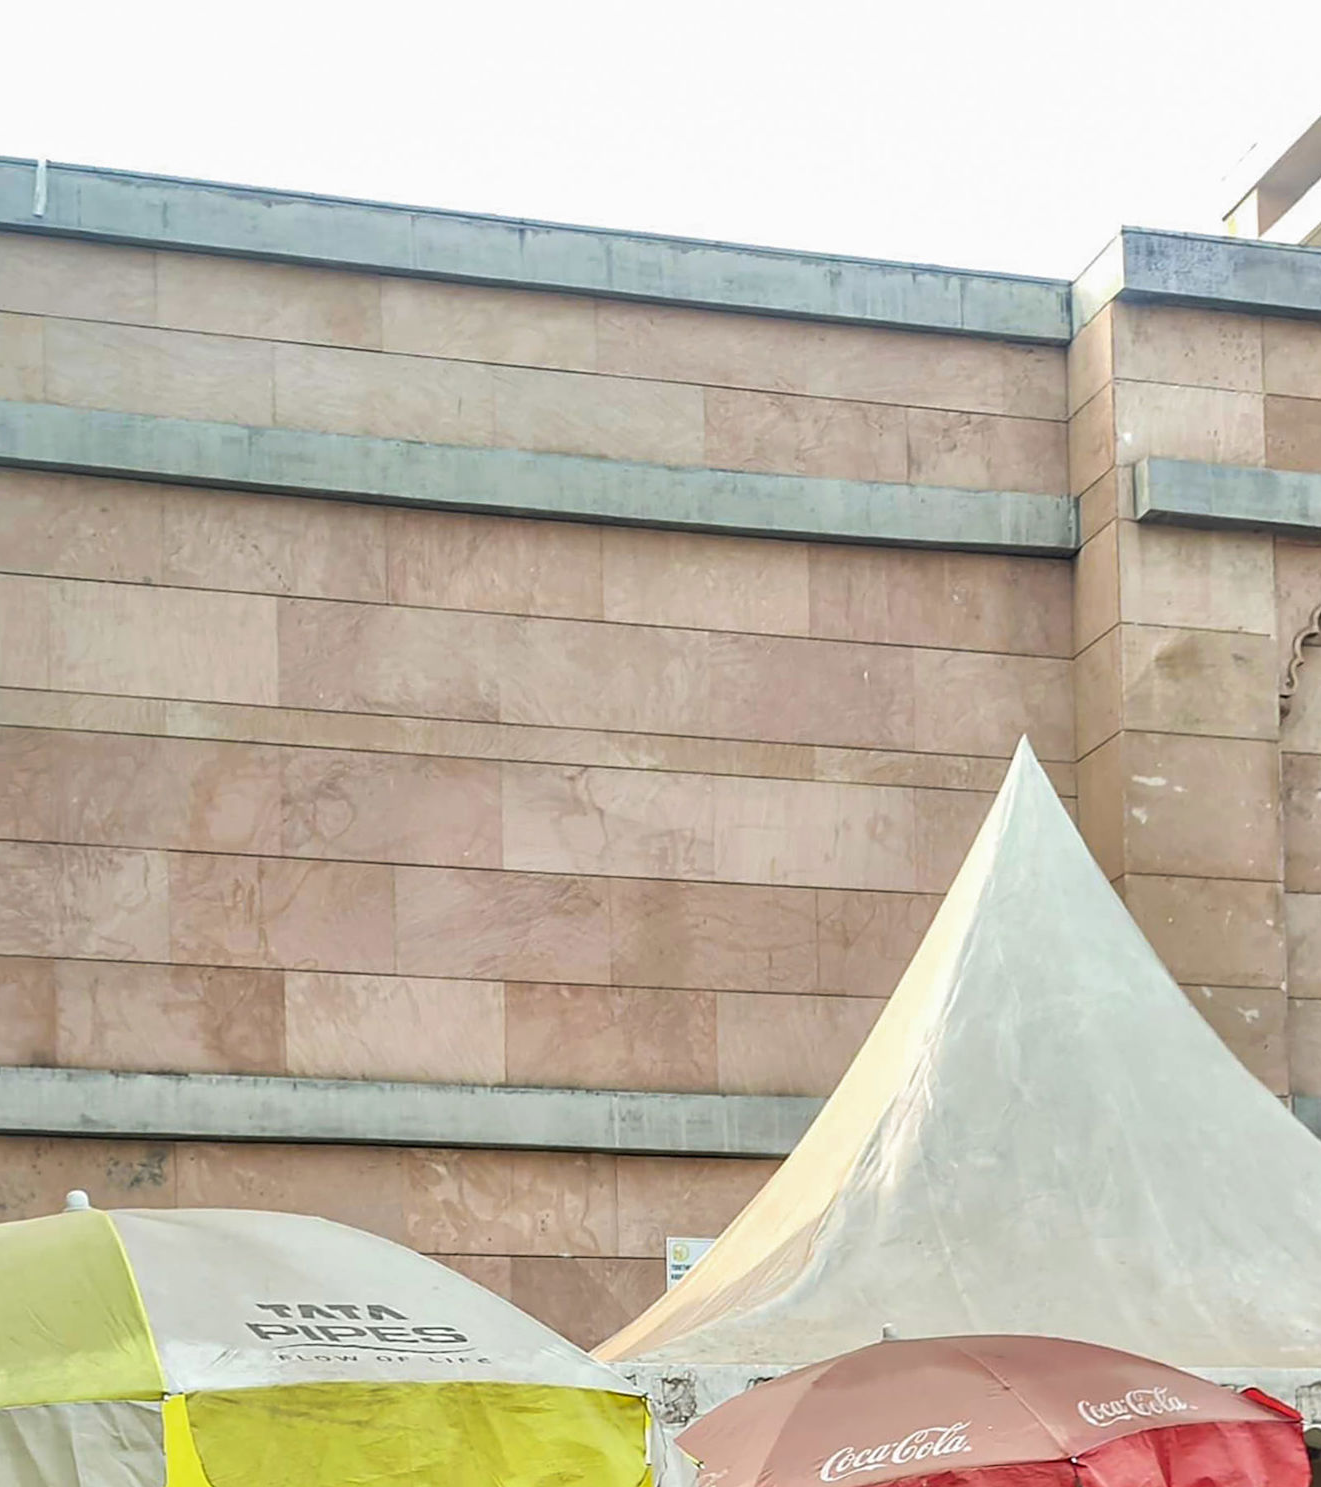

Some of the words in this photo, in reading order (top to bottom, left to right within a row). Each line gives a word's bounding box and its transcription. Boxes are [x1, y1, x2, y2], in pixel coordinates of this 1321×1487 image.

[257, 1303, 408, 1320] TATA
[245, 1322, 469, 1344] PIPES
[278, 1354, 359, 1364] FLOW
[376, 1355, 411, 1364] OF
[1078, 1386, 1196, 1427] Coca-Cola
[820, 1420, 972, 1483] Coca-Cola
